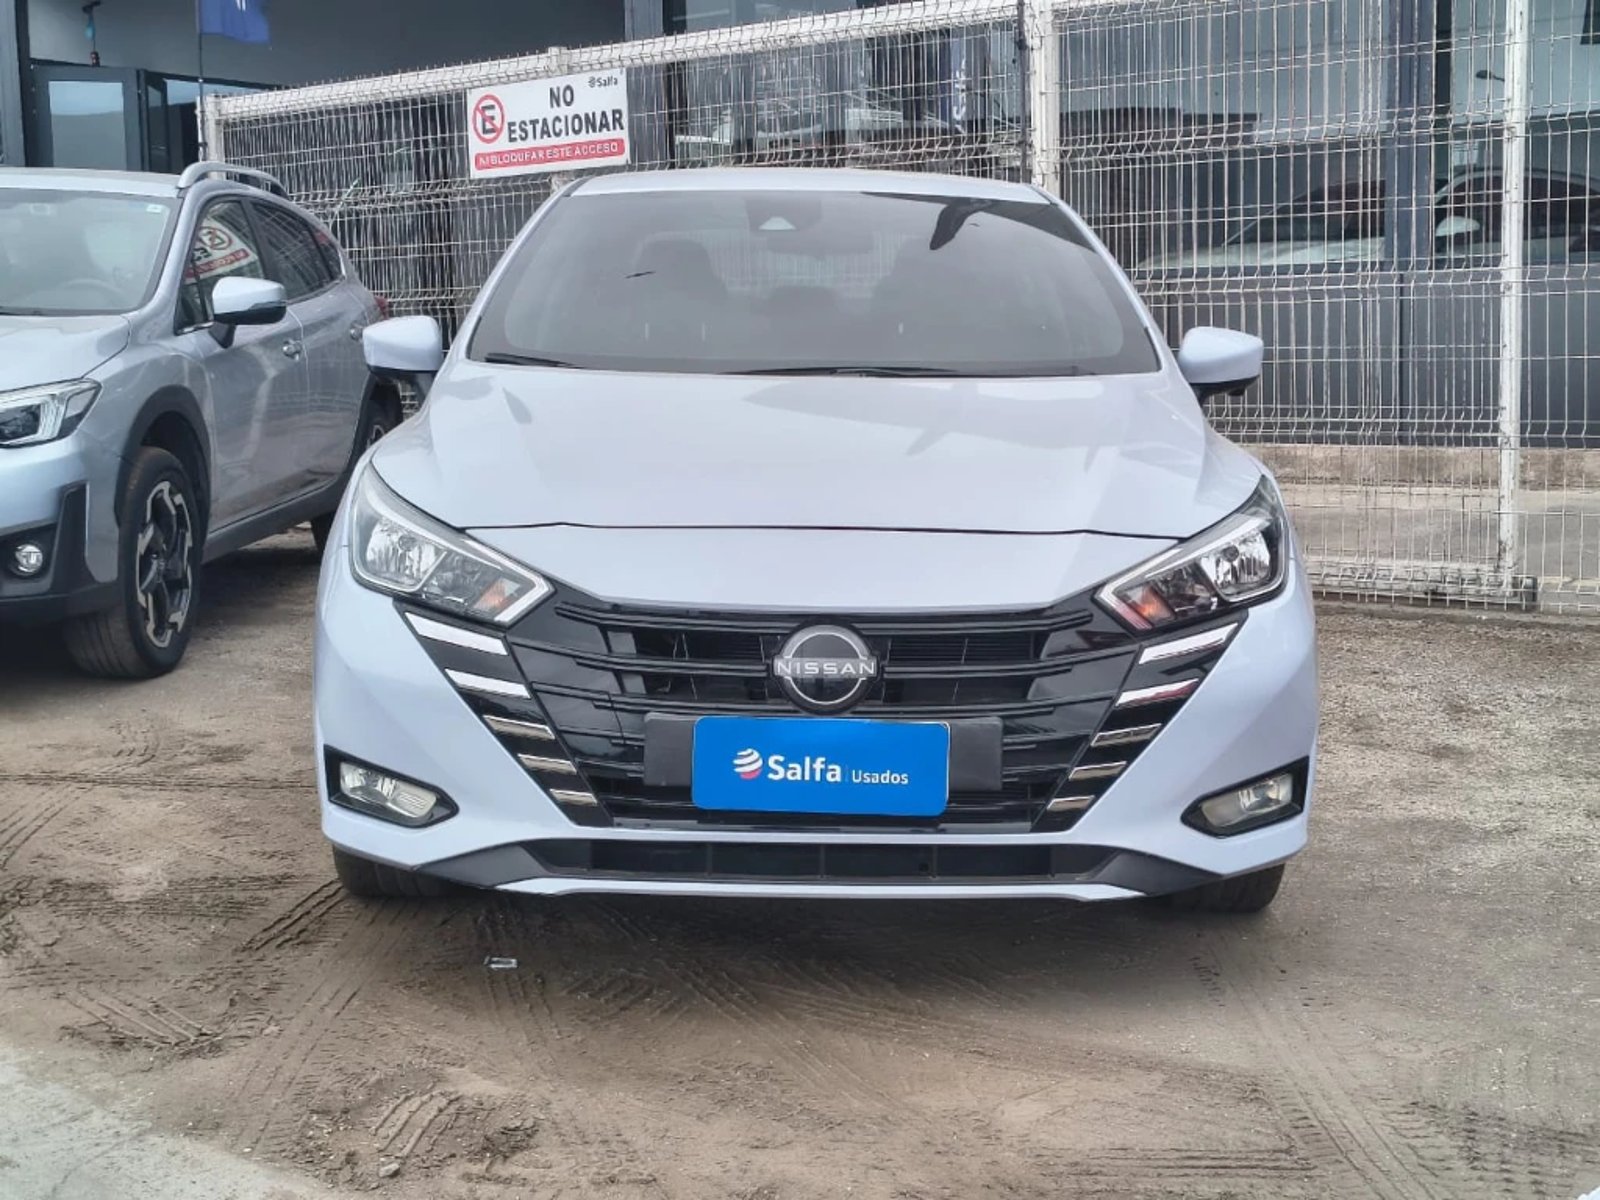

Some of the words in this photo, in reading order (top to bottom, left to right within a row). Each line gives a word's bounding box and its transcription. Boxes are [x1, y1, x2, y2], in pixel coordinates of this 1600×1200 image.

[550, 85, 575, 109] NO
[507, 109, 624, 143] ESTACIONAR
[547, 148, 573, 159] ESTE
[574, 142, 618, 157] ACCESO
[777, 661, 875, 675] NISSAN
[767, 755, 841, 783] Salfa
[852, 770, 909, 784] Usados
